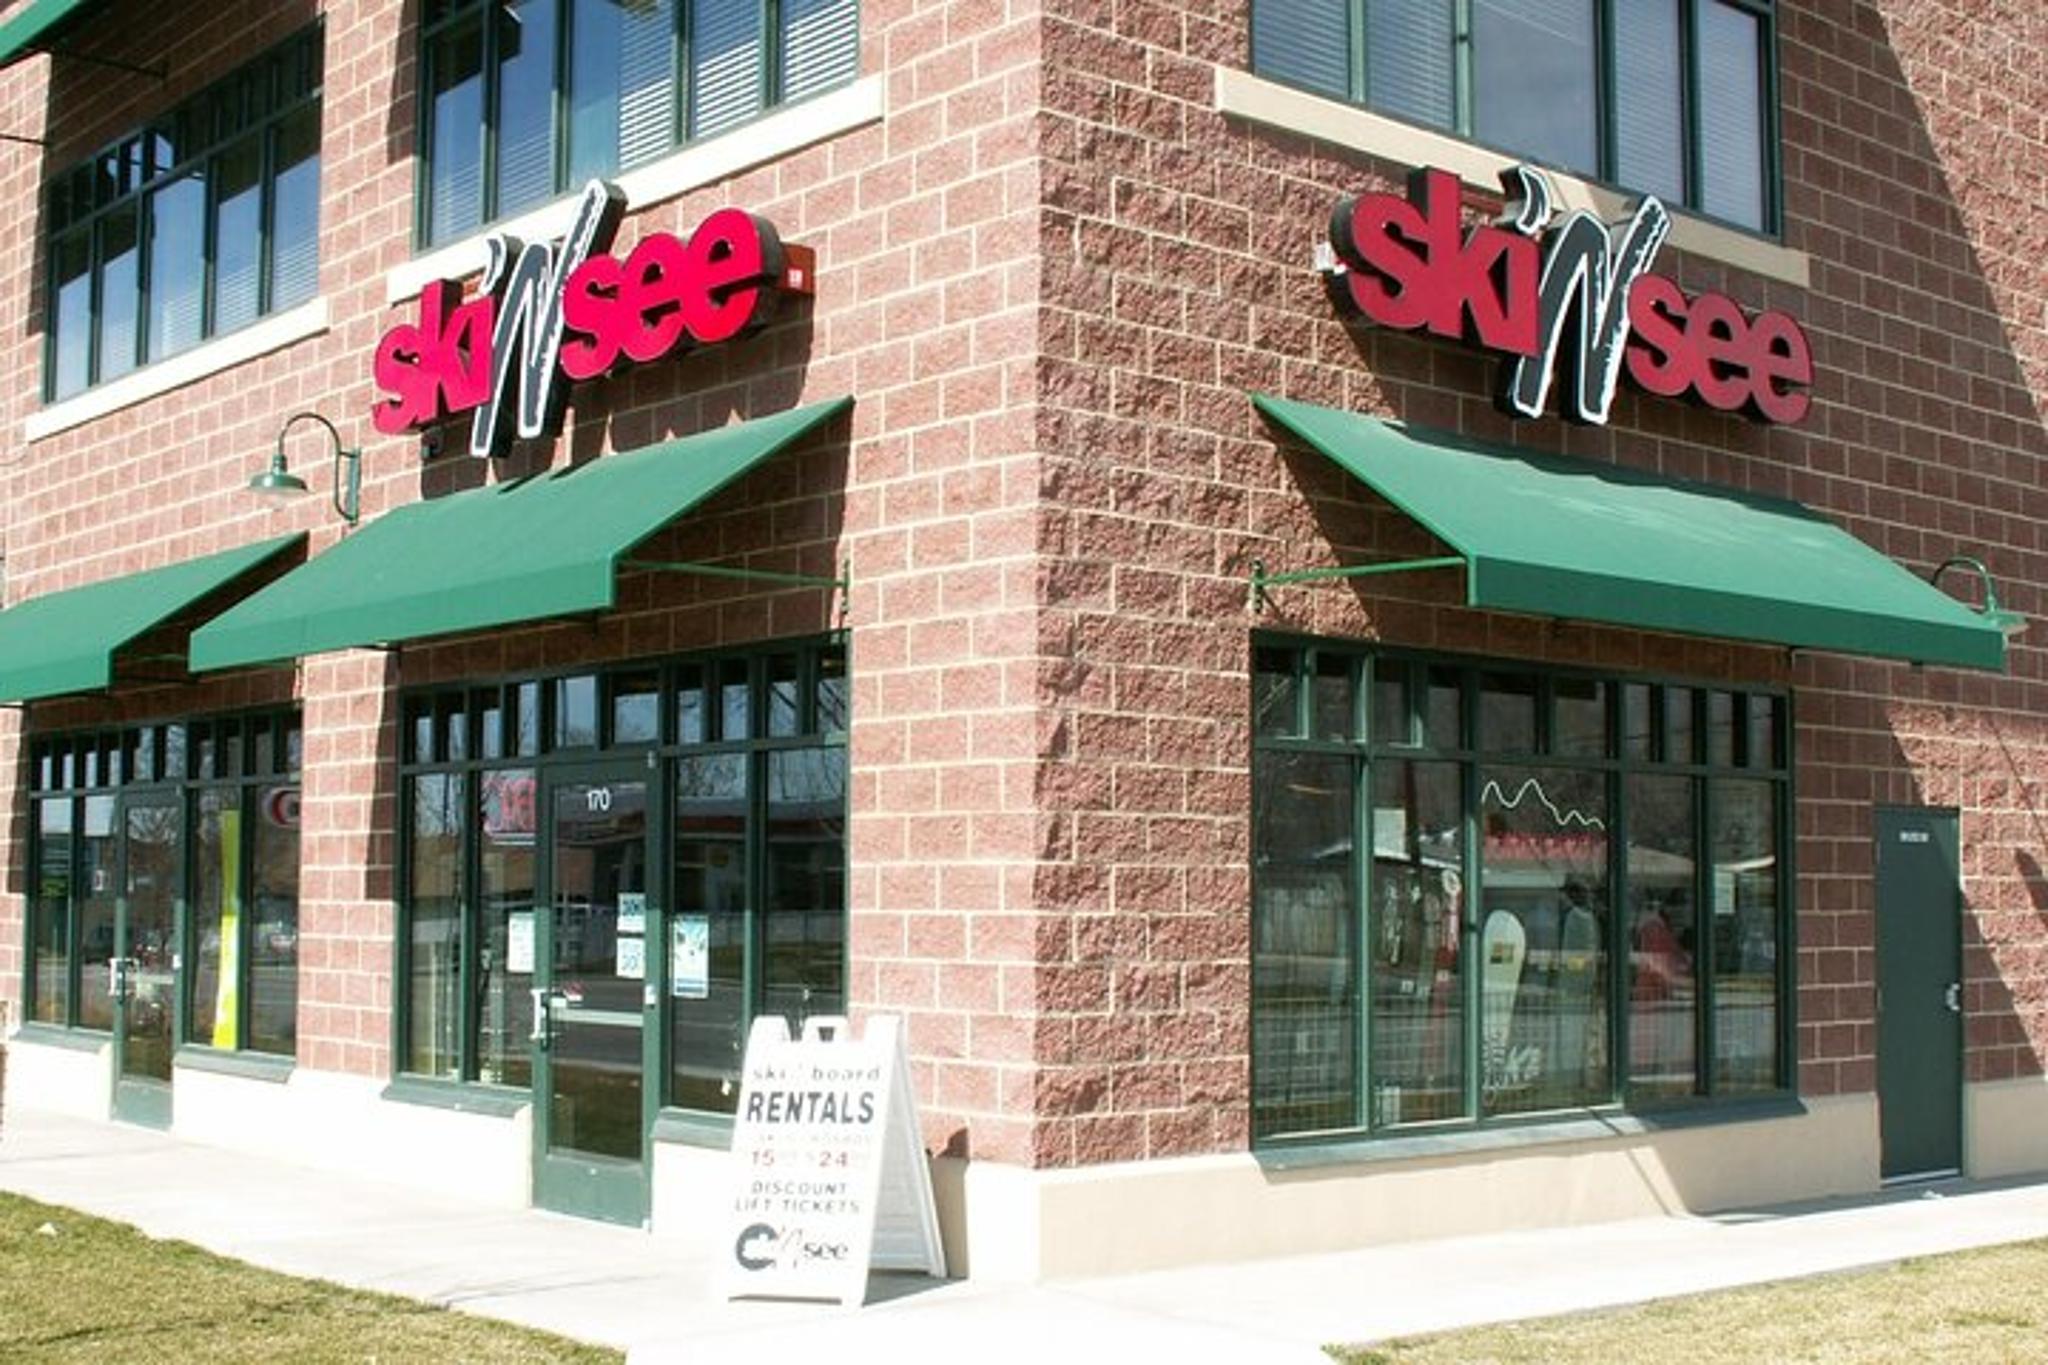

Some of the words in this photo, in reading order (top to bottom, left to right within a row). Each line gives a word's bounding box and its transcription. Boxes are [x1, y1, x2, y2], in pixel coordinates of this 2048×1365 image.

[587, 787, 610, 811] 170
[812, 1064, 880, 1082] board
[747, 1091, 874, 1124] RENTALS
[751, 1180, 848, 1195] DISCOUNT
[734, 1197, 772, 1213] LIFT
[782, 1198, 861, 1214] TICKETS
